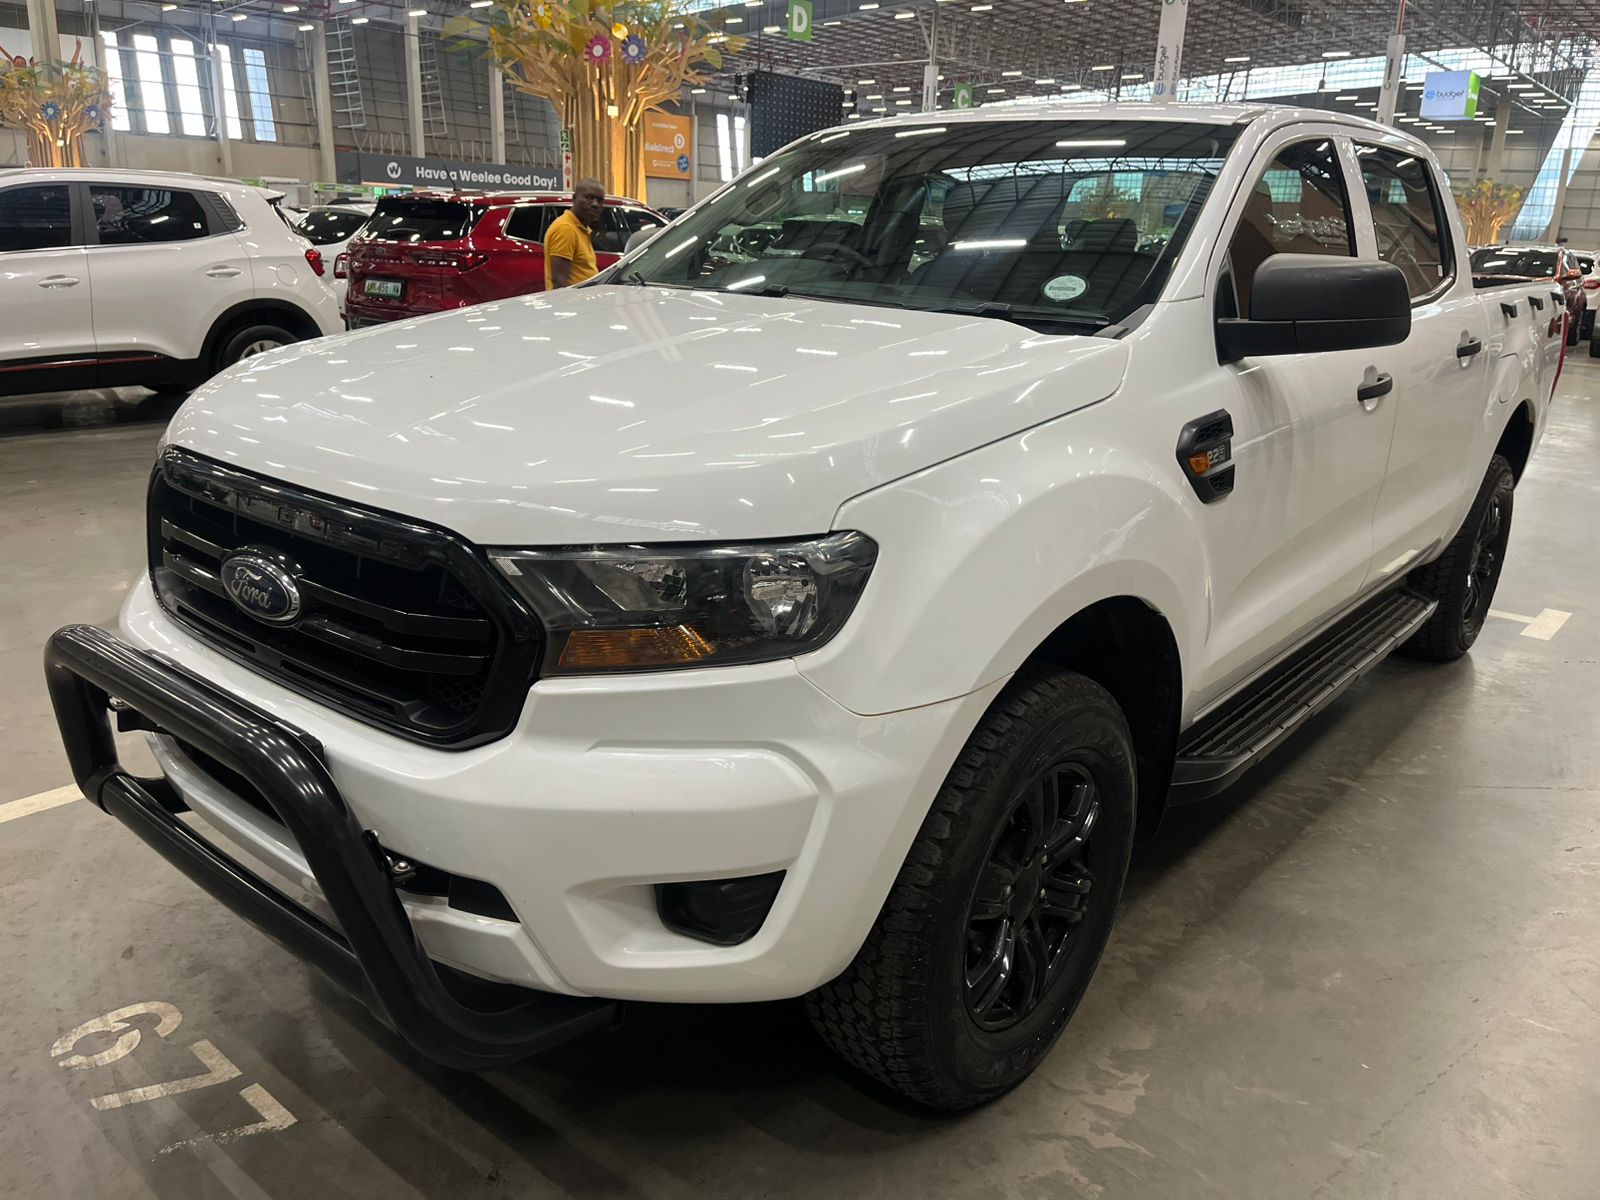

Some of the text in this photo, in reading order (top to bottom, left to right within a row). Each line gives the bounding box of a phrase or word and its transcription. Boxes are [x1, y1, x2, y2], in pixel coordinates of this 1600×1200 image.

[792, 4, 808, 33] D
[1156, 44, 1170, 81] budget
[957, 89, 969, 109] C
[1436, 90, 1465, 98] budget
[415, 166, 558, 190] Have a Weelee Good Day!
[230, 562, 273, 608] Ford
